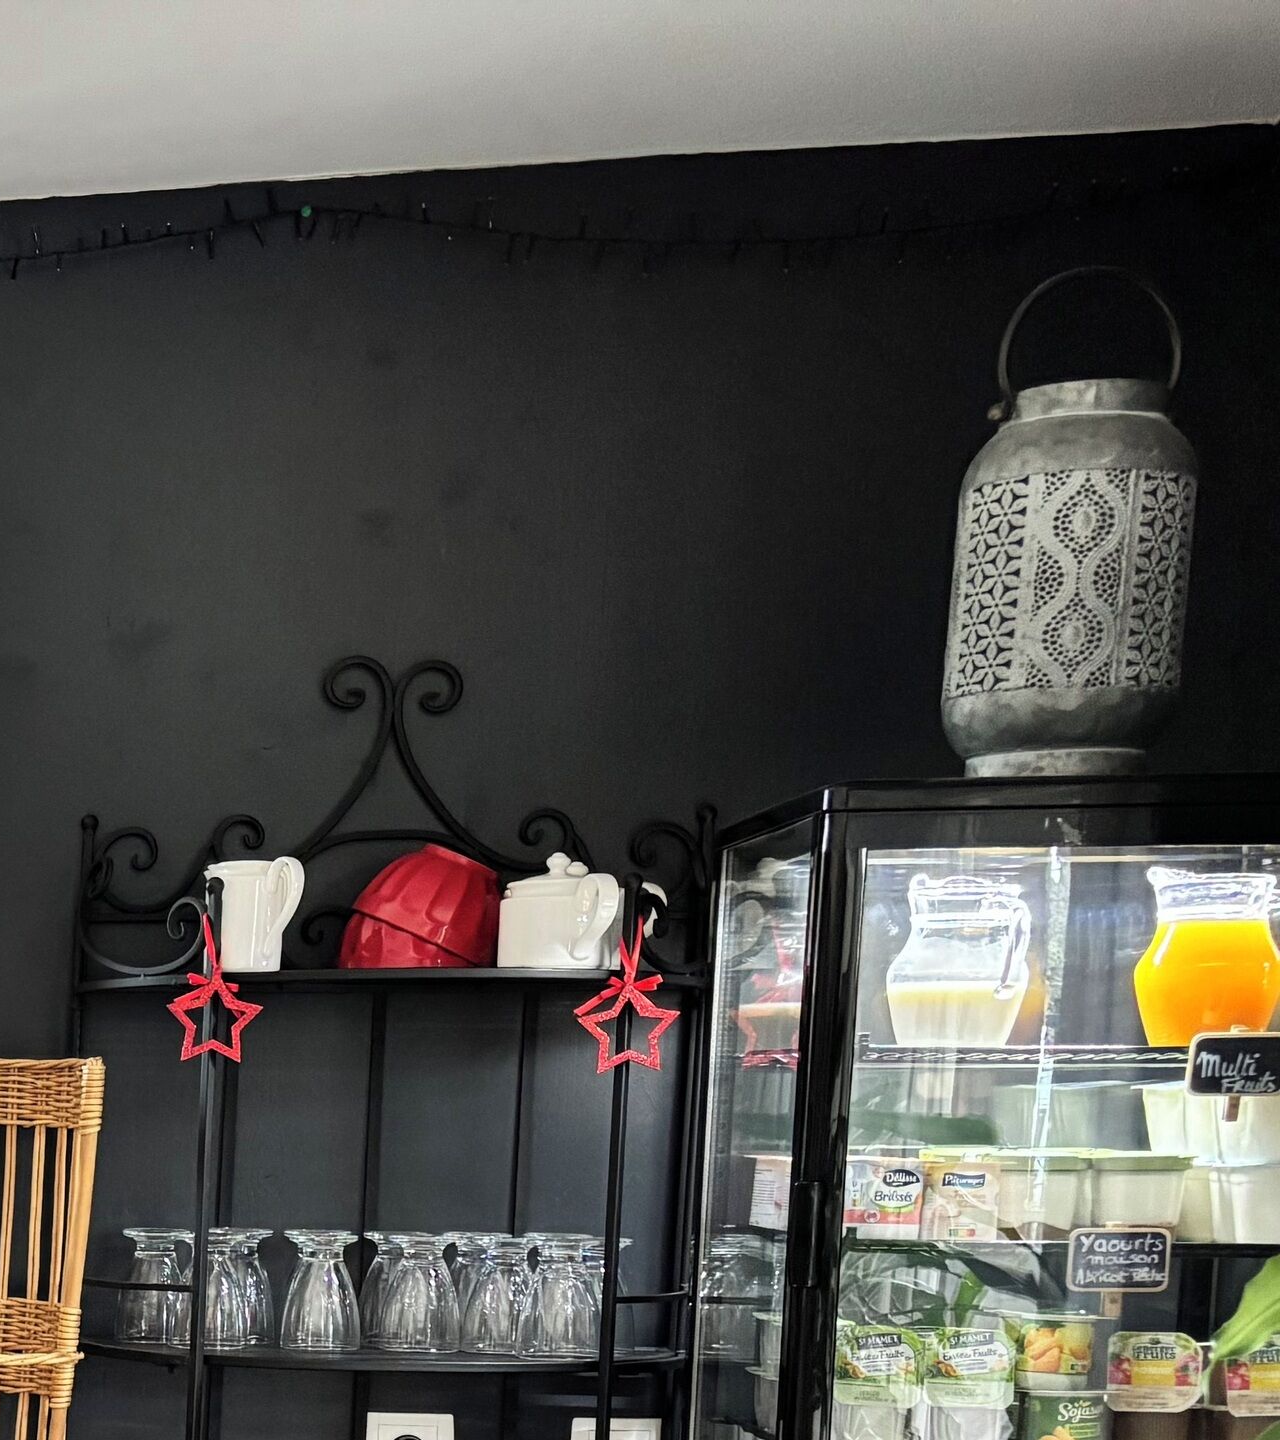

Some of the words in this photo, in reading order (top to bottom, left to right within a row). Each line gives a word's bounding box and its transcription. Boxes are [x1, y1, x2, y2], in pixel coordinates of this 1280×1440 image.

[1196, 1051, 1261, 1078] Multi
[1080, 1234, 1164, 1252] Yaourts
[1084, 1252, 1159, 1265] maison
